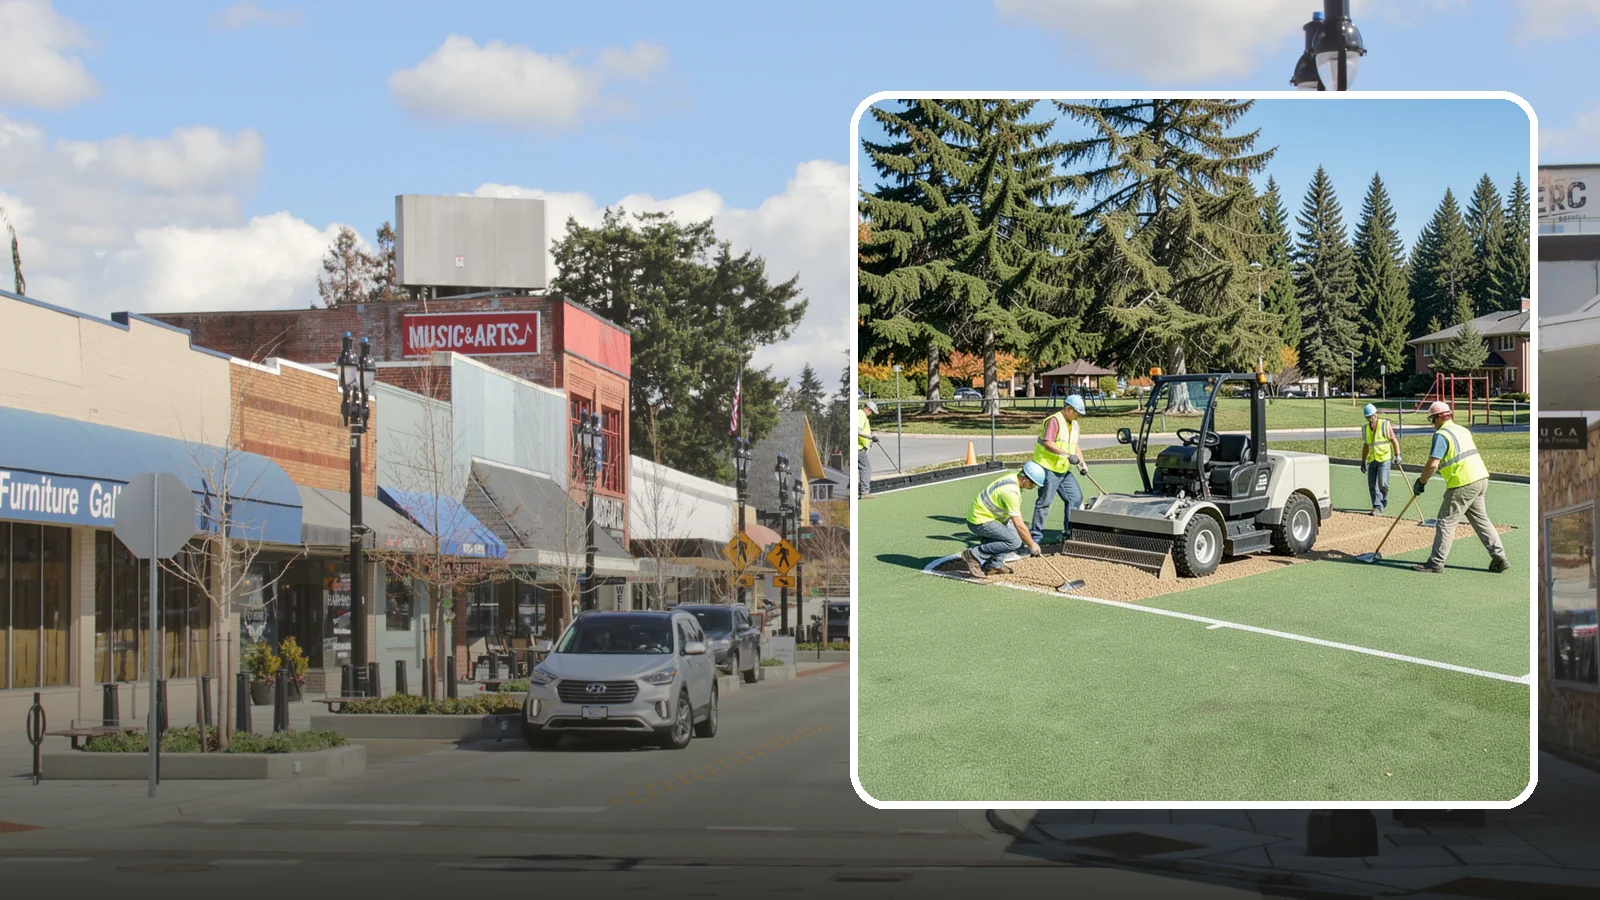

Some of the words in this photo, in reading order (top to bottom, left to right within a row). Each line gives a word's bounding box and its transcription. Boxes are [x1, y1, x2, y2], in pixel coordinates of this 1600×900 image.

[0, 471, 79, 515] Furniture
[89, 482, 121, 519] Gal
[452, 563, 479, 574] SUSHI
